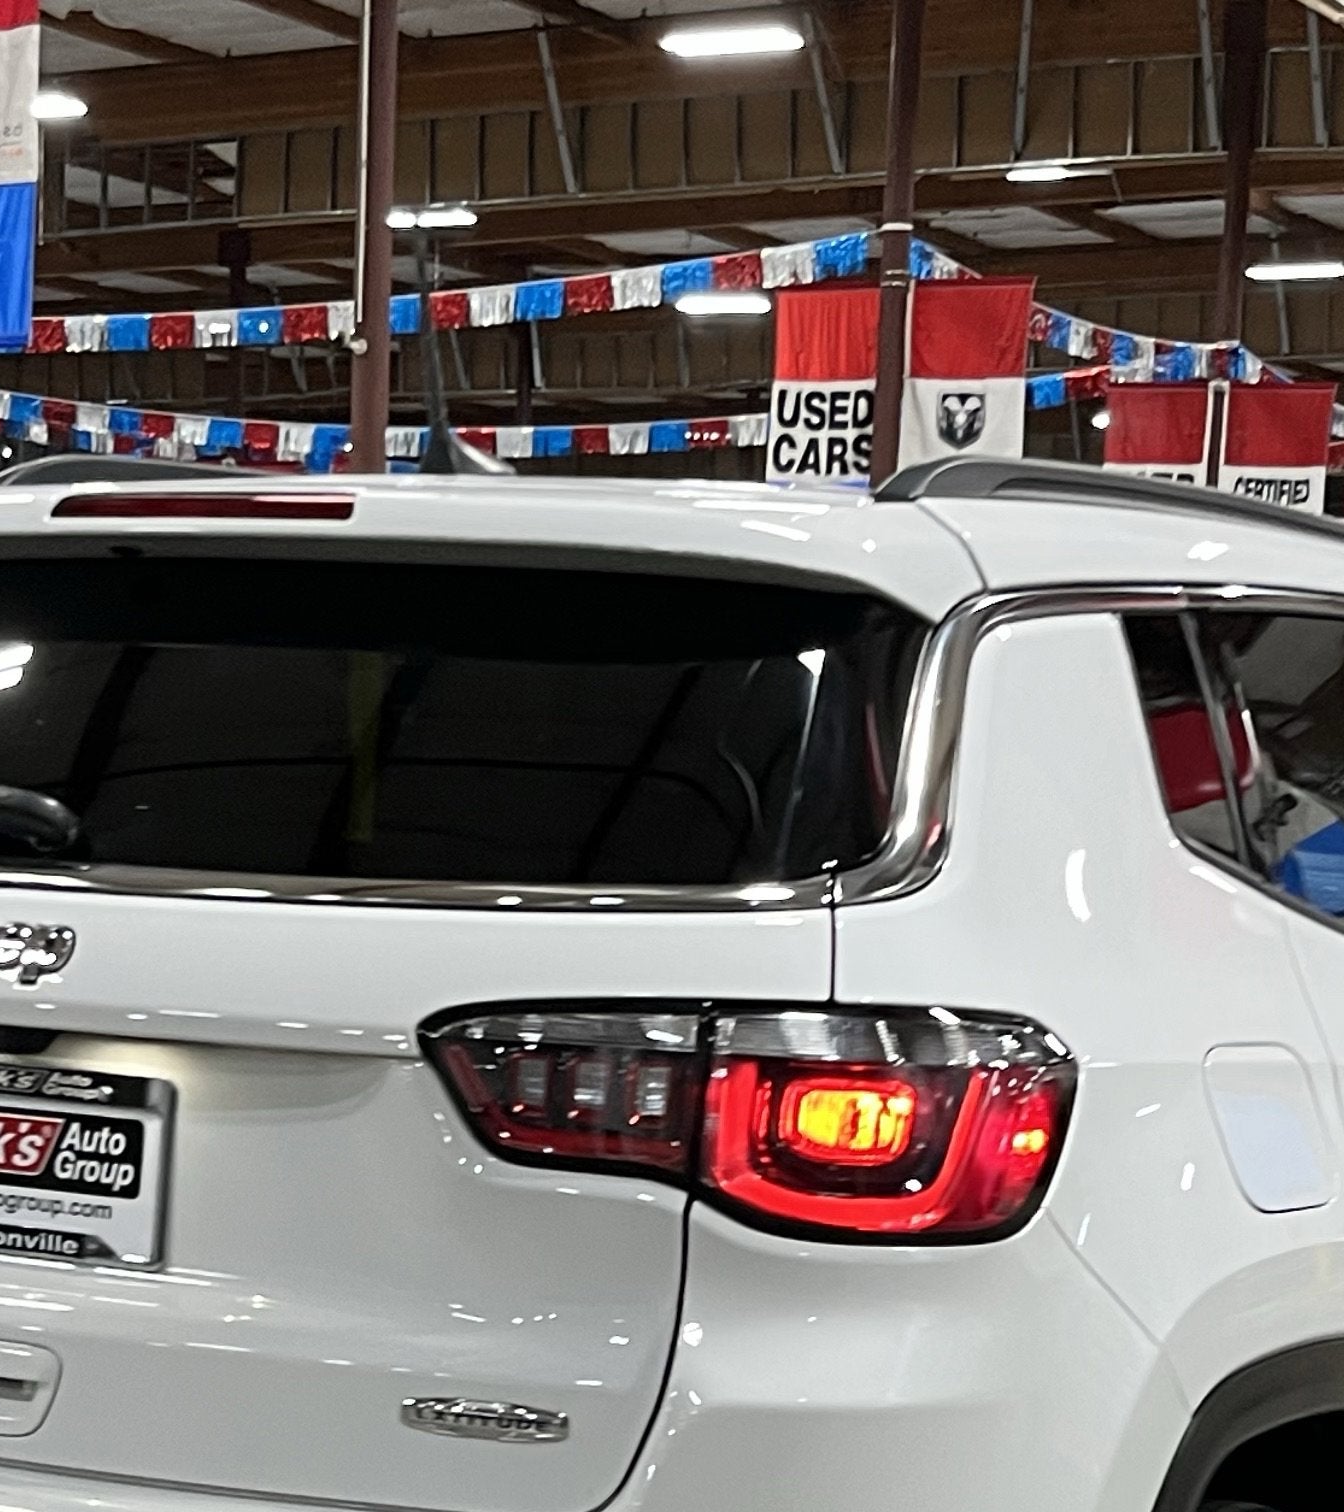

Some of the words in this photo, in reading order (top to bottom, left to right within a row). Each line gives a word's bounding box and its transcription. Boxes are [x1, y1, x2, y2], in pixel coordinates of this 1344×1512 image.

[776, 389, 875, 431] USED
[772, 433, 873, 476] CARS
[60, 1121, 127, 1157] Auto
[53, 1150, 136, 1191] Group
